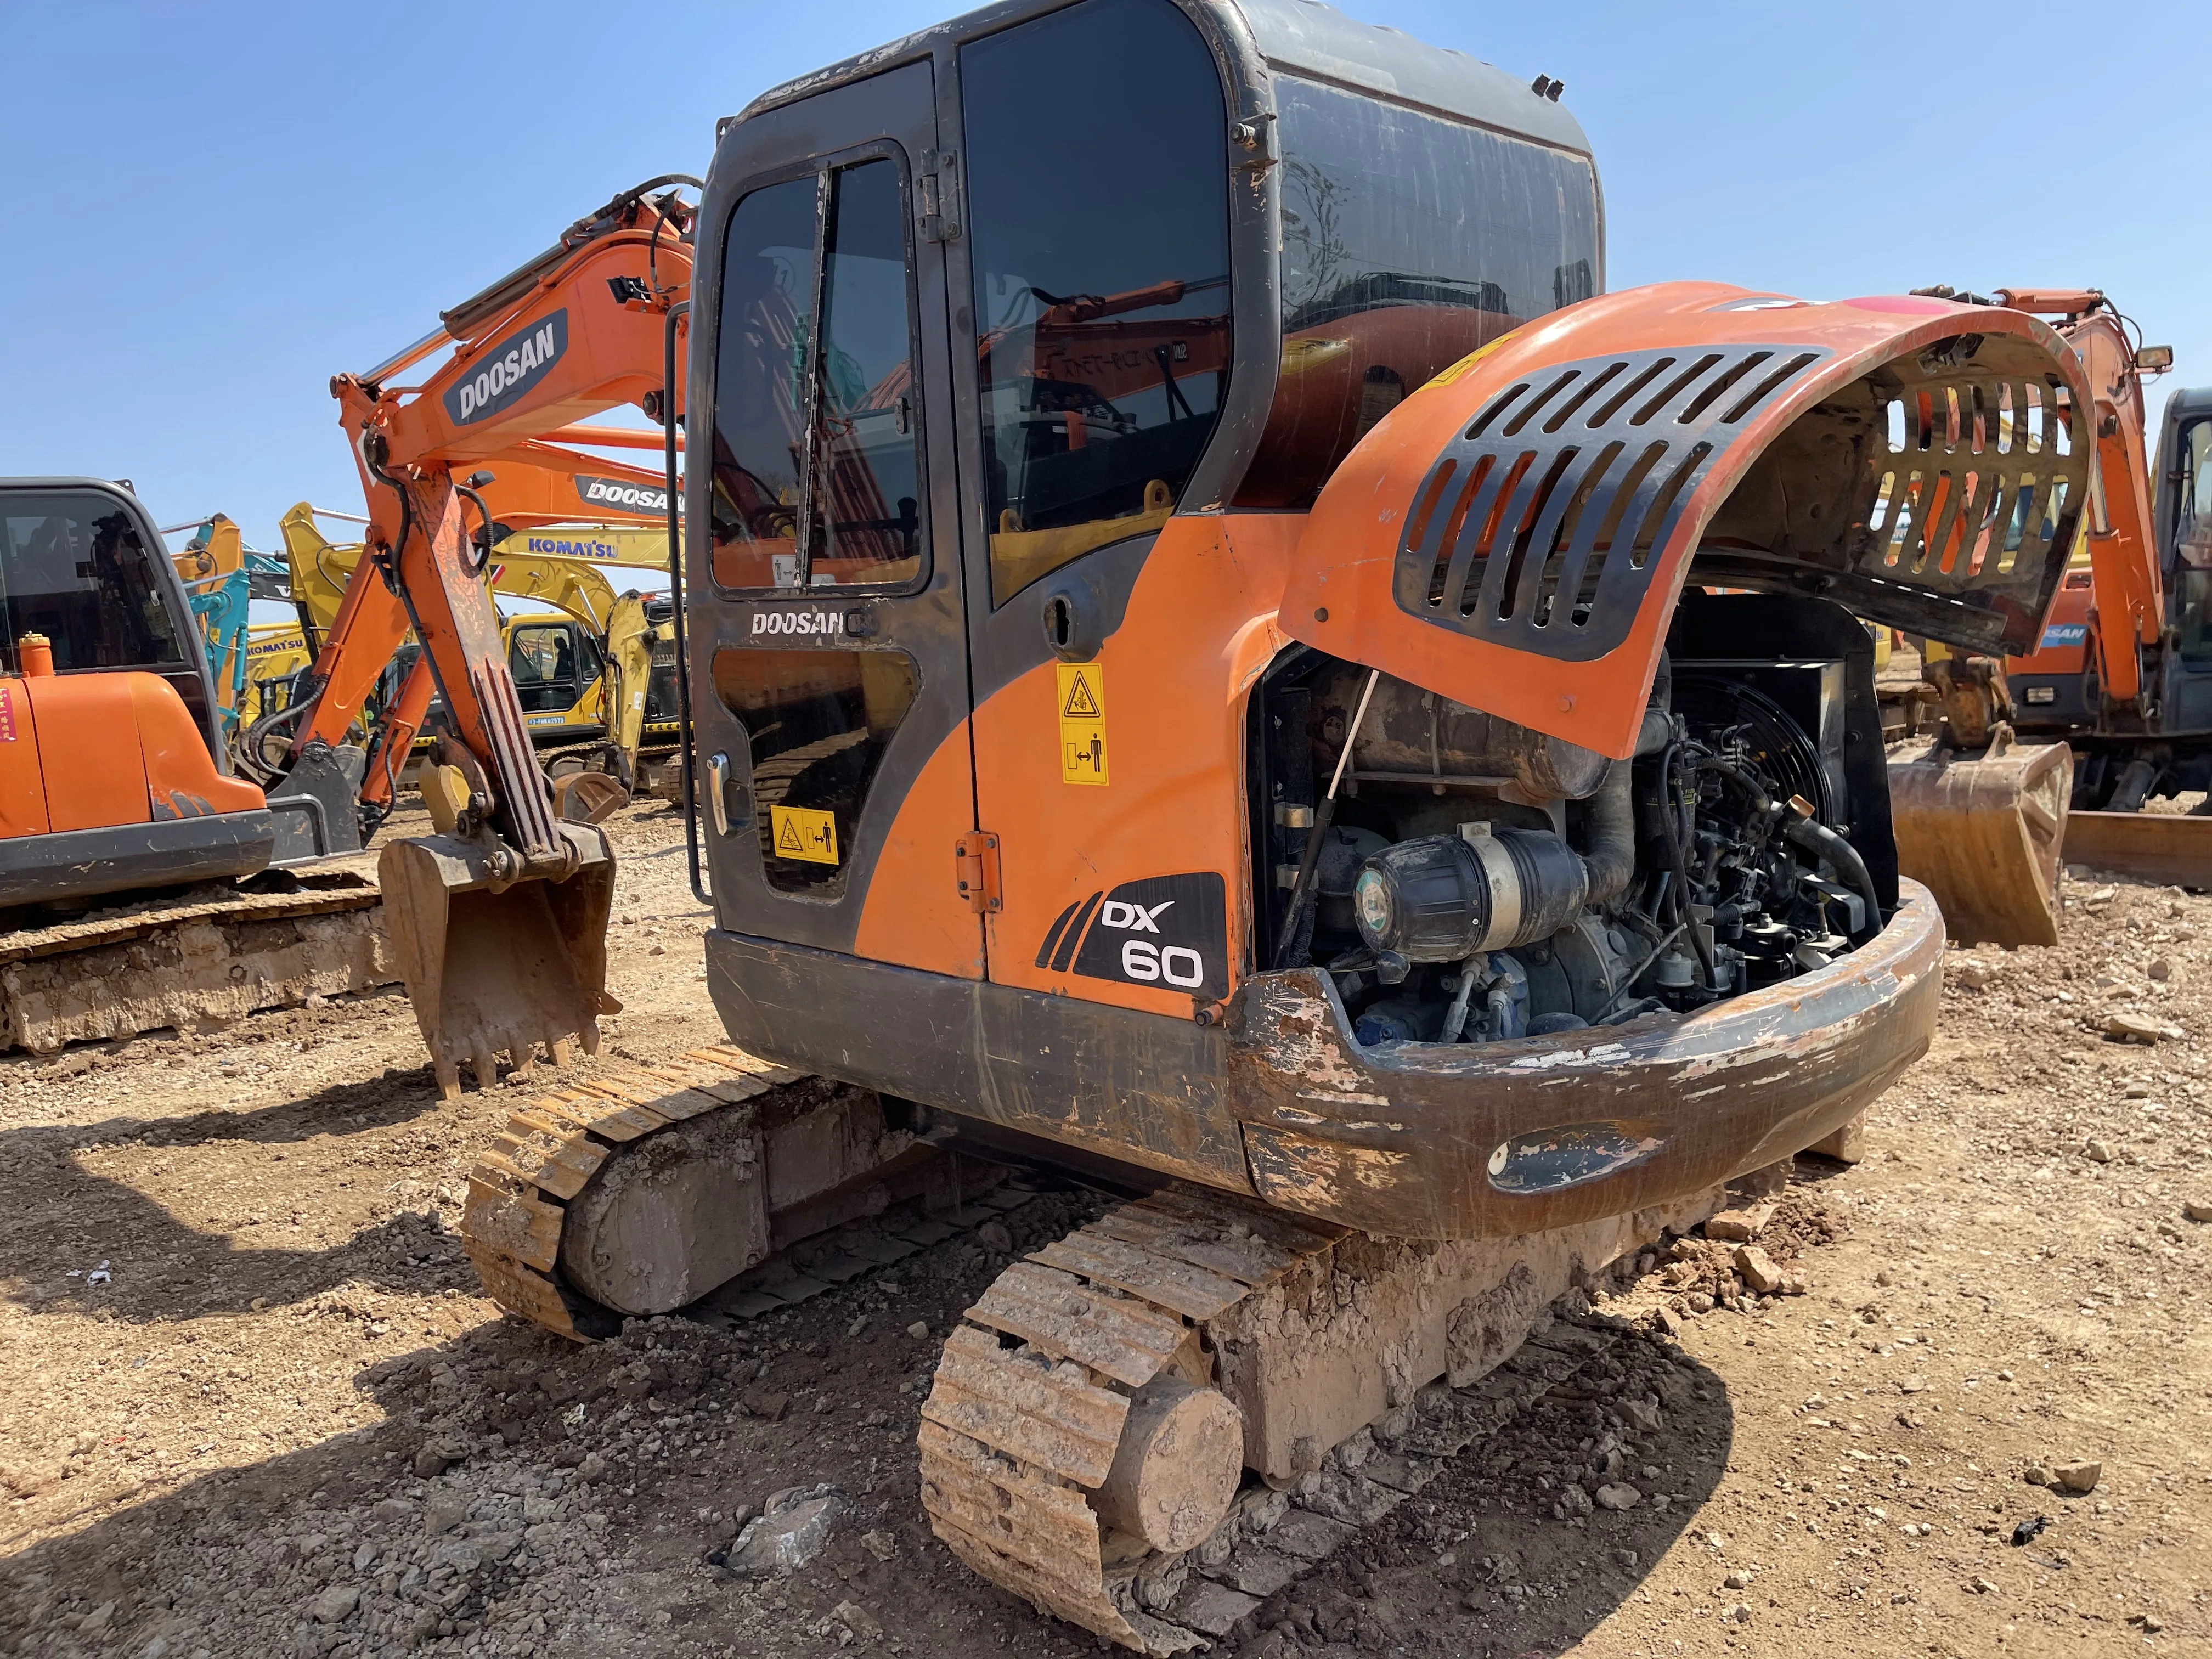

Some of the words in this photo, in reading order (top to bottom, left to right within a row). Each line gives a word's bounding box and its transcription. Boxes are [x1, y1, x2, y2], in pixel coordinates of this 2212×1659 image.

[460, 322, 555, 420] DOOSAN
[528, 538, 618, 558] KOMATSU
[752, 612, 844, 635] DOOSAN
[247, 639, 303, 656] KOMATSU
[1101, 900, 1176, 933] DX
[1122, 939, 1204, 988] 60
